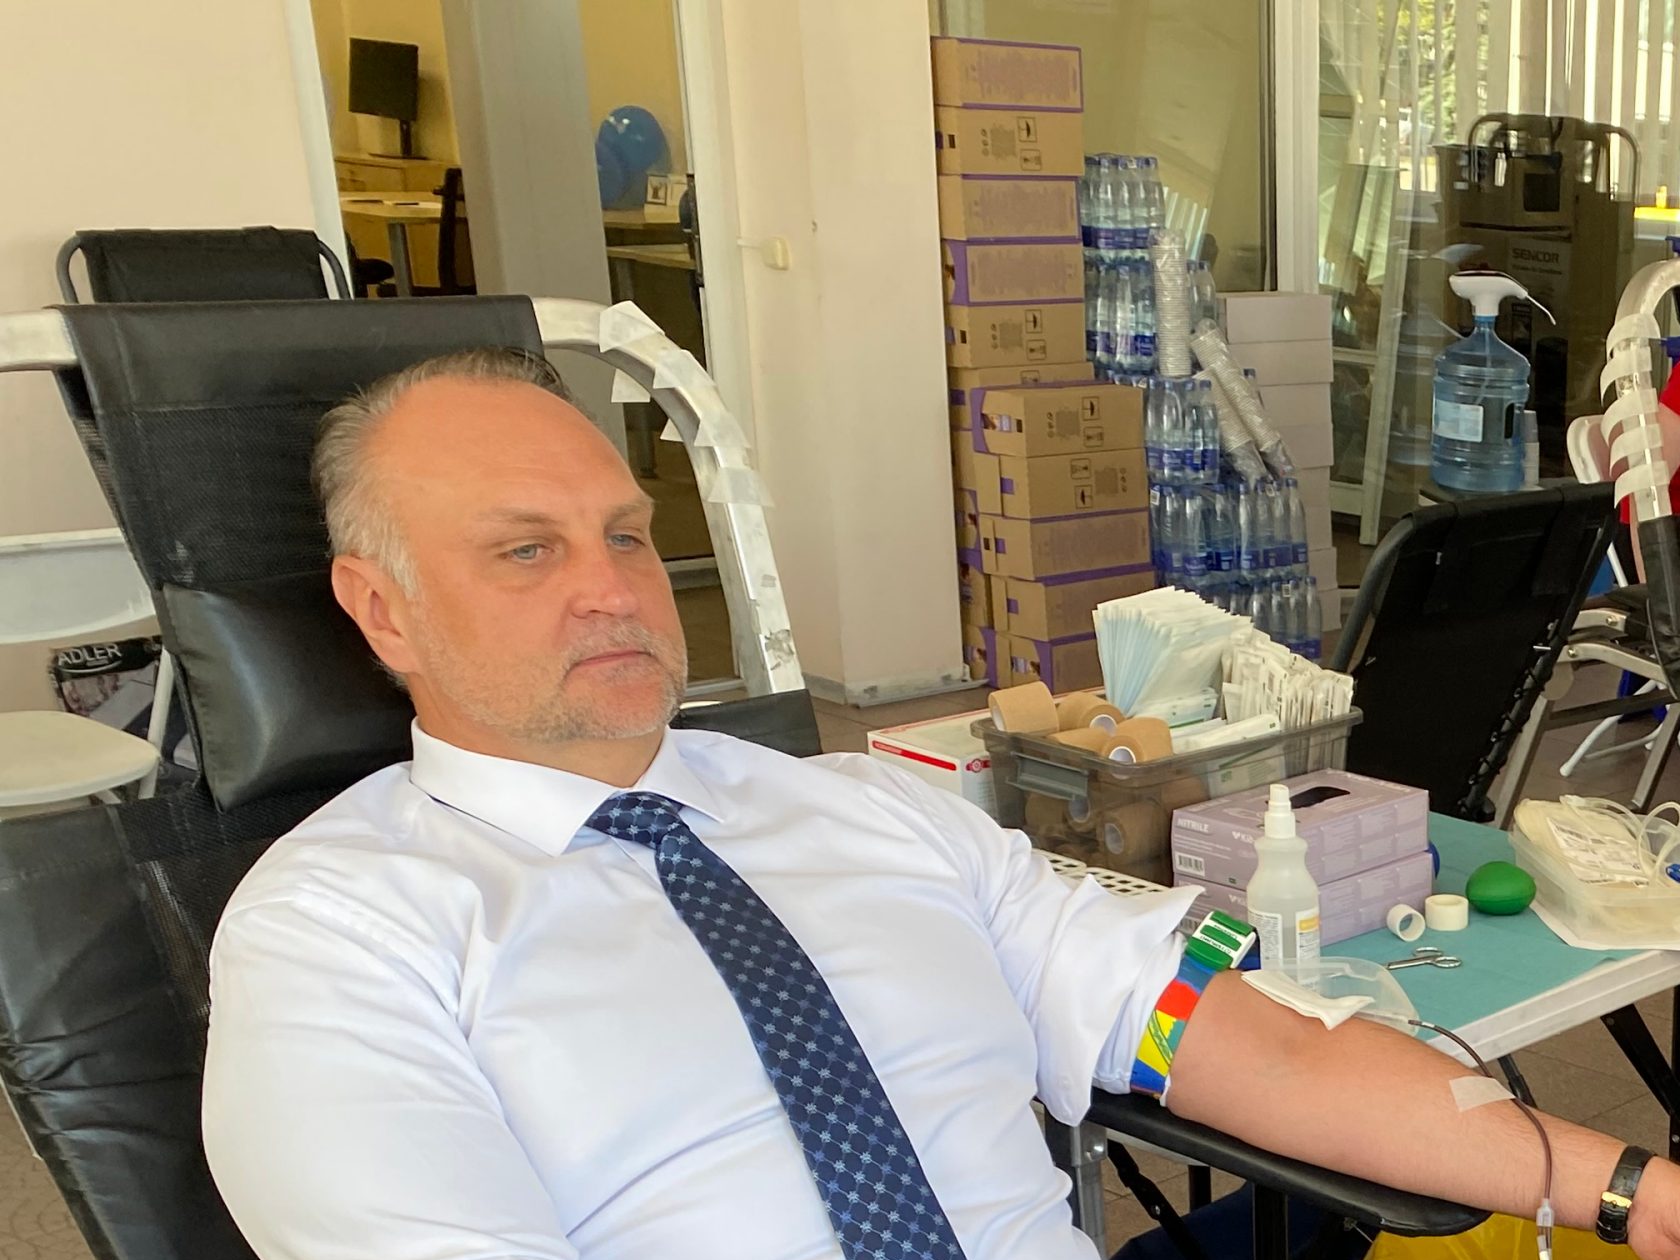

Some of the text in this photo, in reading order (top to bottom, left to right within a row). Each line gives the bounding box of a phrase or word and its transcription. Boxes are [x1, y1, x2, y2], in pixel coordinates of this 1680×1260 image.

[1512, 248, 1560, 263] SENCOR
[58, 643, 122, 666] ADLER
[1177, 819, 1209, 833] NITRILE
